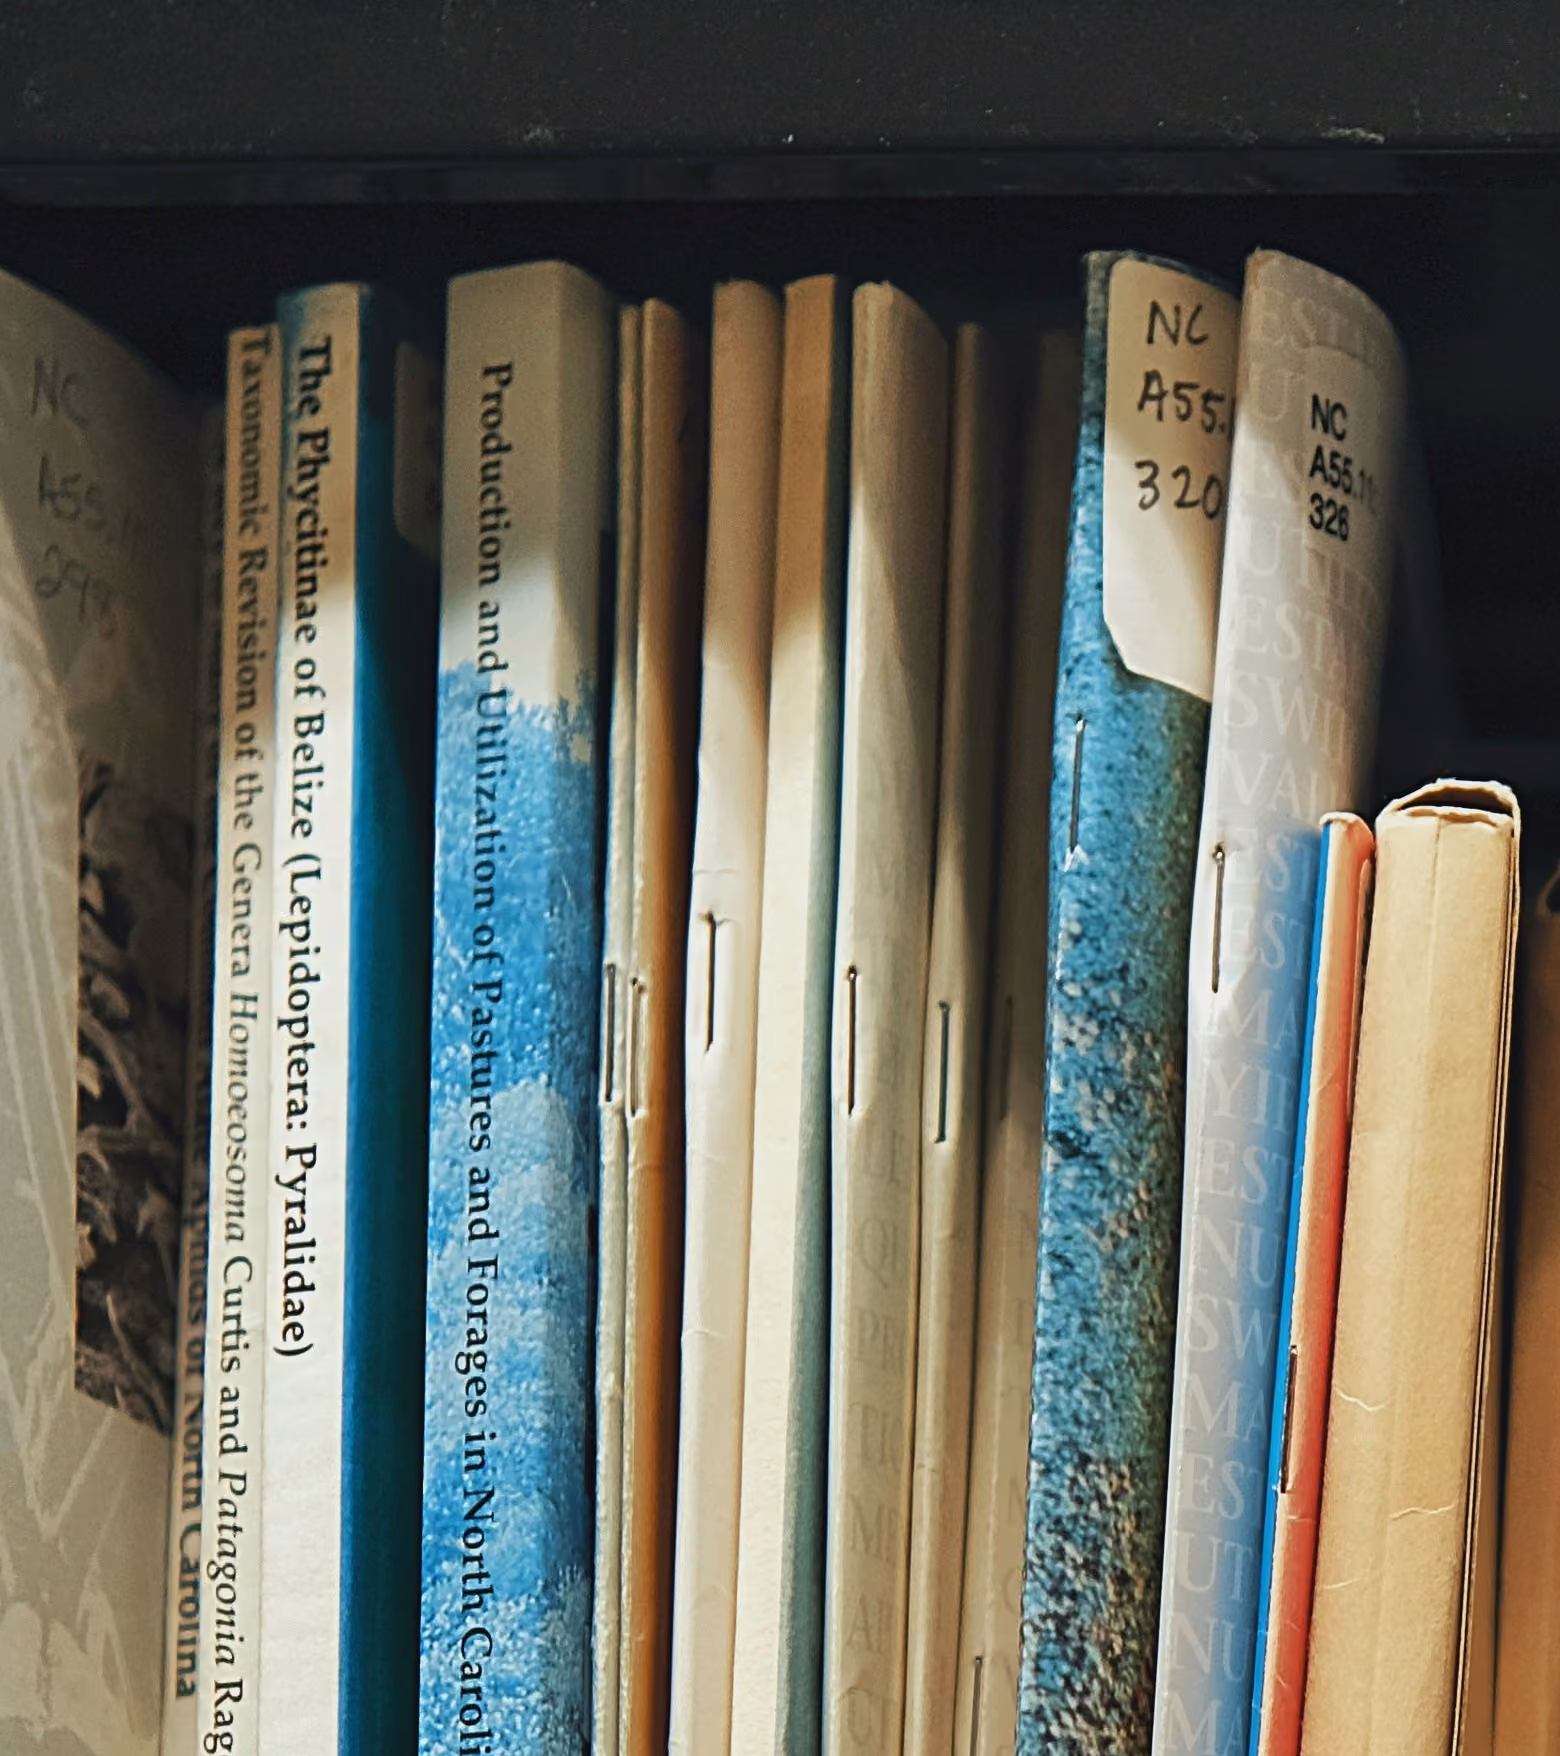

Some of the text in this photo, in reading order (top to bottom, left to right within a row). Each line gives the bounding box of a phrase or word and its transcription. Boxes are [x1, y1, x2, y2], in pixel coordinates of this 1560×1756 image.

[1146, 300, 1210, 346] NC
[235, 333, 273, 537] Taxonomic
[475, 361, 516, 586] Production
[1311, 394, 1347, 441] NC
[1135, 459, 1225, 520] 320
[1308, 492, 1349, 542] 326
[233, 549, 269, 712] Revision
[475, 599, 511, 674] and
[232, 772, 266, 831] the
[234, 722, 266, 764] of
[470, 688, 510, 910] Utilization
[270, 335, 334, 1358] The Phycitinae of Belize (Lepidoptera: Pyralidae)
[227, 841, 264, 977] Genera
[469, 924, 505, 969] of
[466, 980, 505, 1152] Pastures
[464, 1166, 501, 1242] and
[217, 1256, 253, 1374] Curtis
[452, 1256, 500, 1418] Forages
[215, 1385, 251, 1456] and
[461, 1431, 497, 1474] in
[204, 1468, 248, 1666] Patagonia
[459, 1486, 496, 1614] North
[173, 1523, 204, 1699] Carolina
